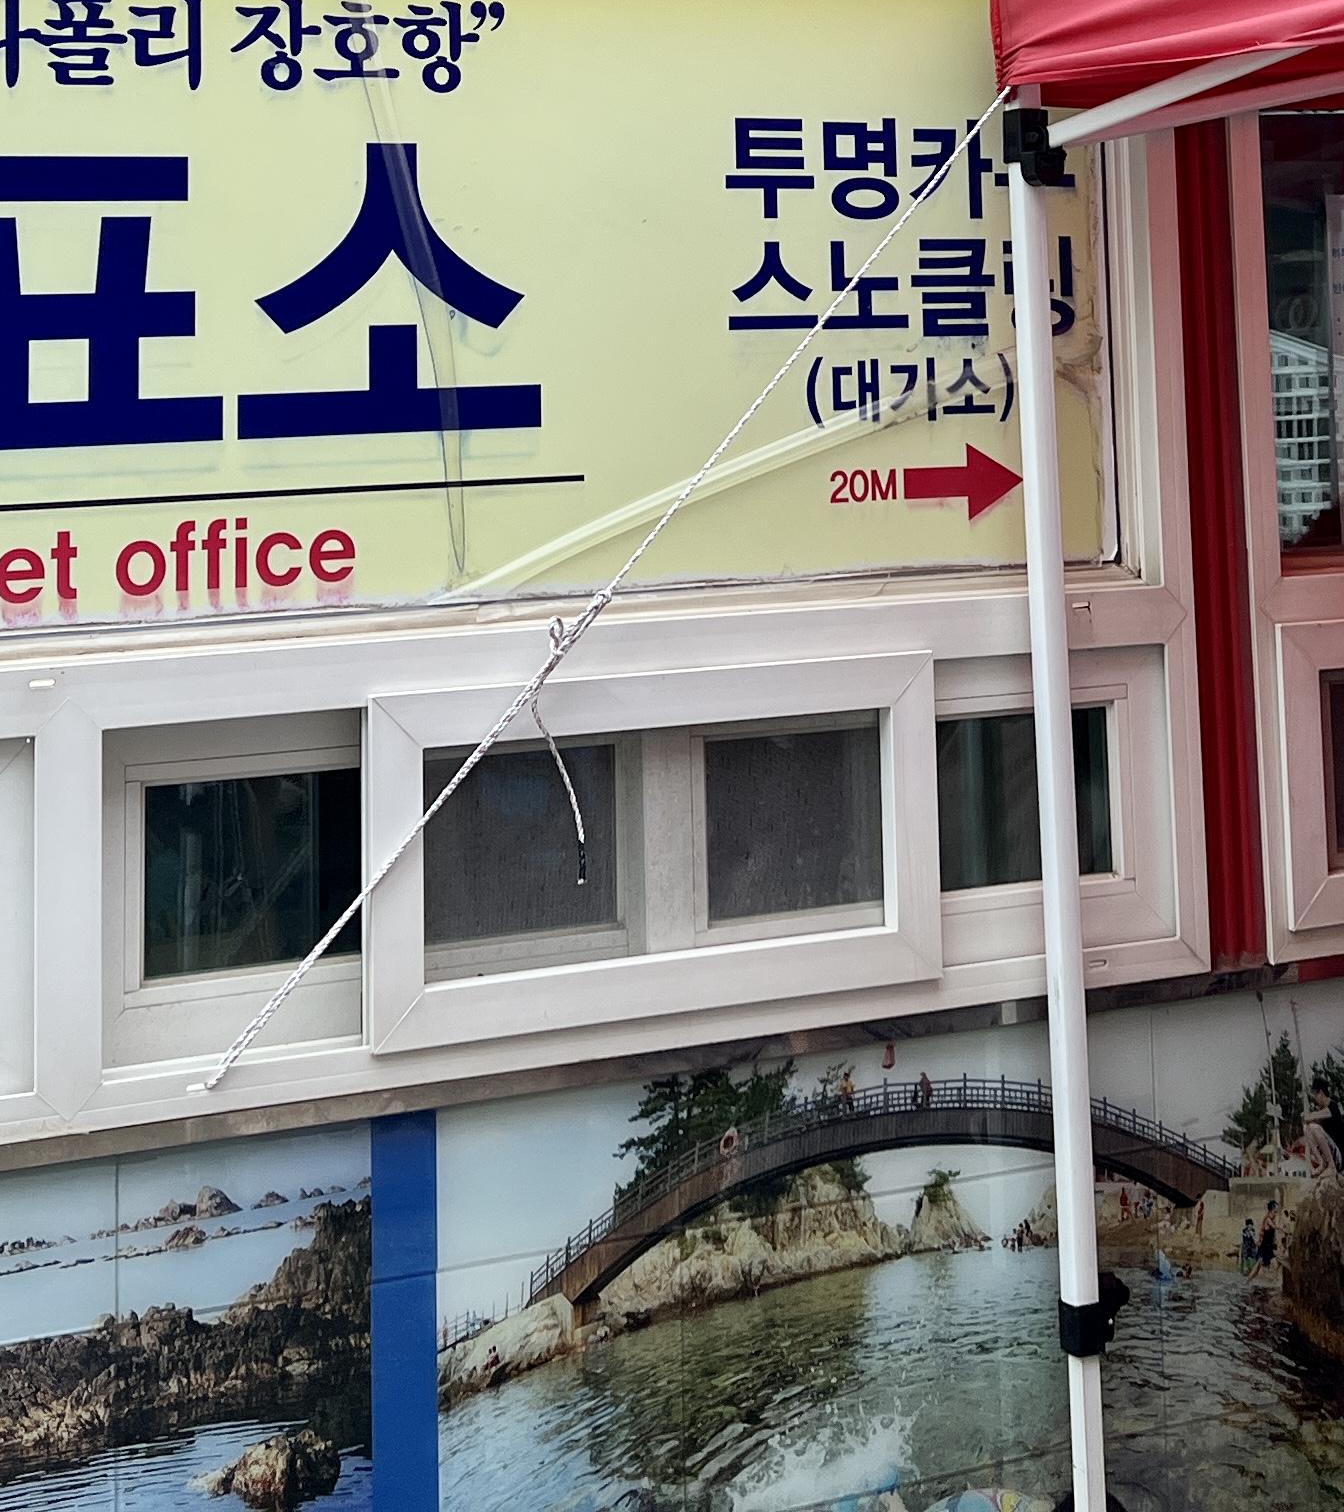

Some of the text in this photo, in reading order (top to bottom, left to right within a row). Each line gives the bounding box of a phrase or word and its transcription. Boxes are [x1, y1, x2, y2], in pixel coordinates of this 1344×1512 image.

[725, 118, 1075, 220] 투명카
[806, 352, 1015, 429] (대기소)
[830, 469, 898, 504] 20M
[115, 517, 357, 599] office
